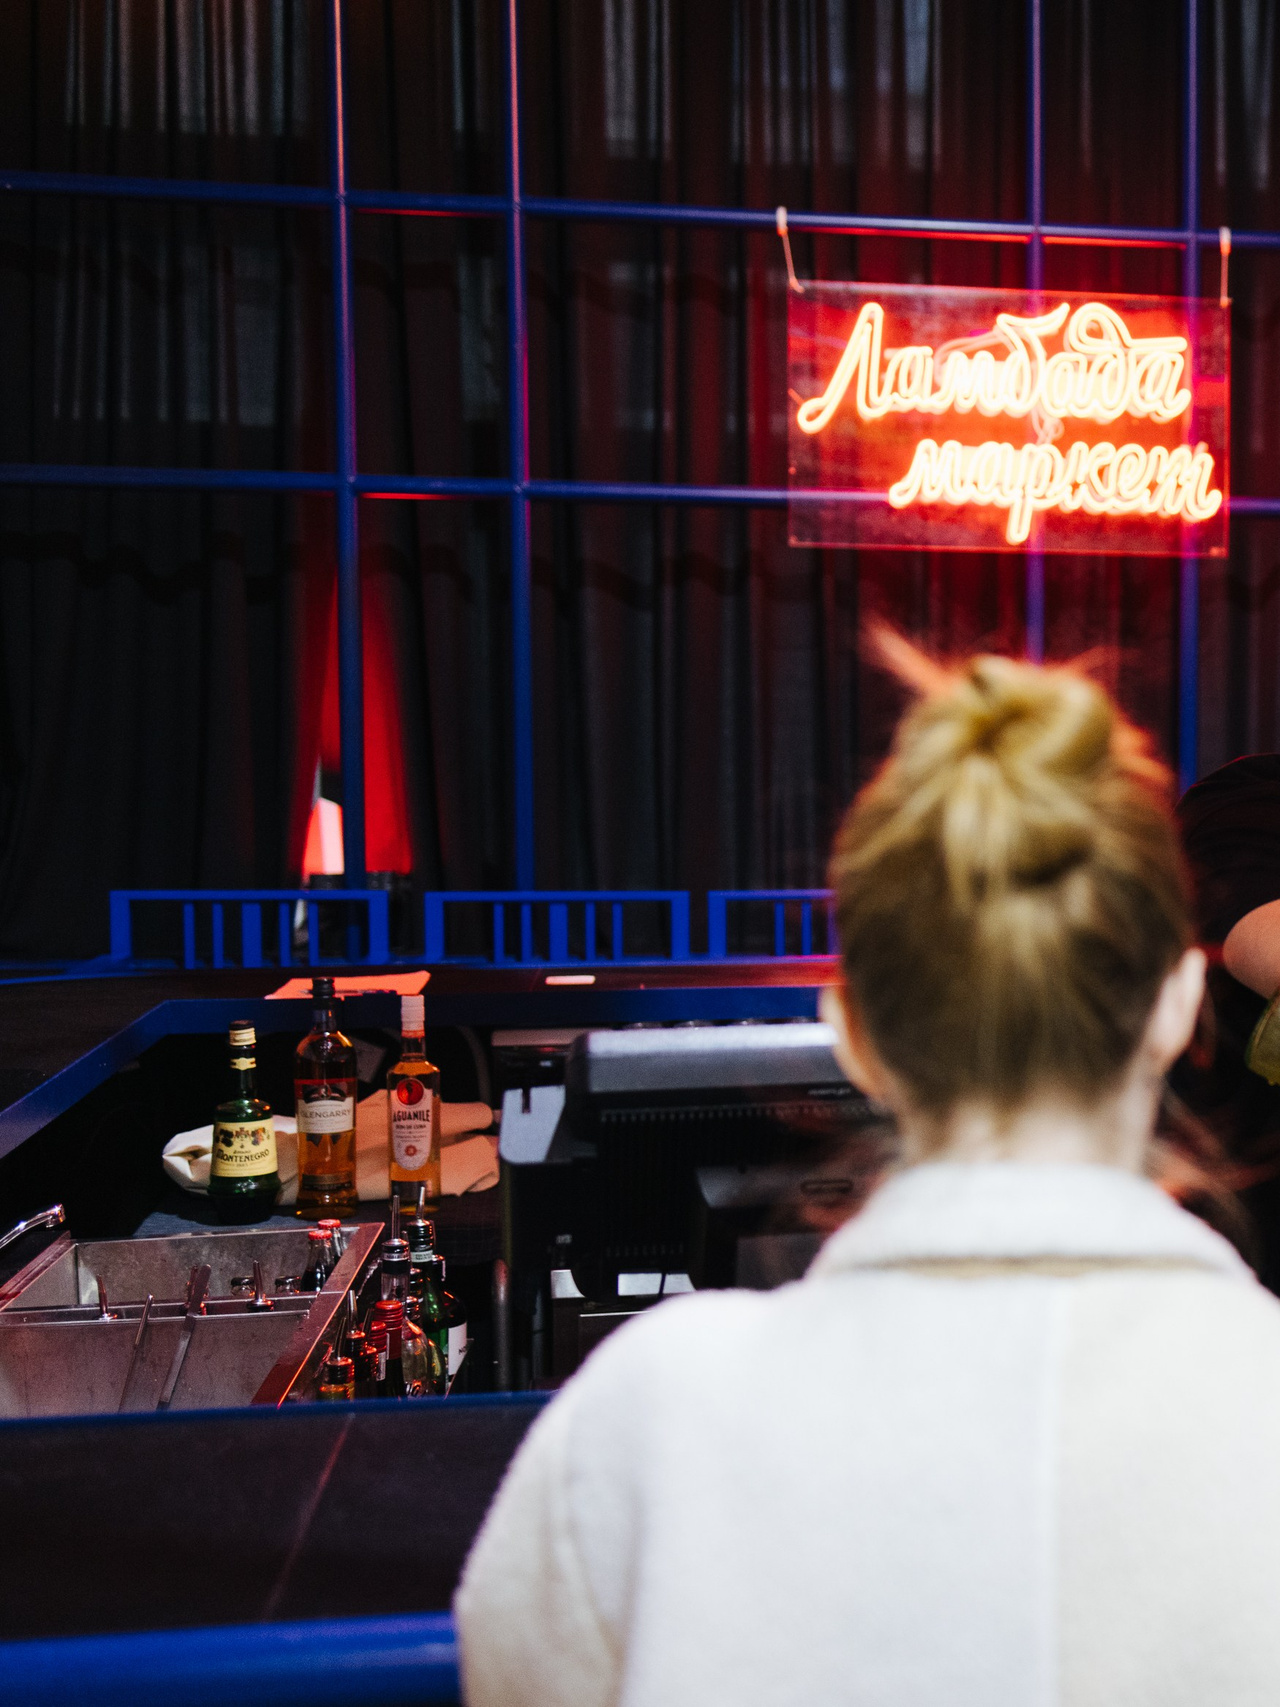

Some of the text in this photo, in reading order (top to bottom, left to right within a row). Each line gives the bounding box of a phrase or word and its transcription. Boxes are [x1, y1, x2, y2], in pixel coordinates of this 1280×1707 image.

[797, 300, 1191, 434] Ламбада
[888, 438, 1223, 545] маркет
[393, 1110, 430, 1122] AGUANILE
